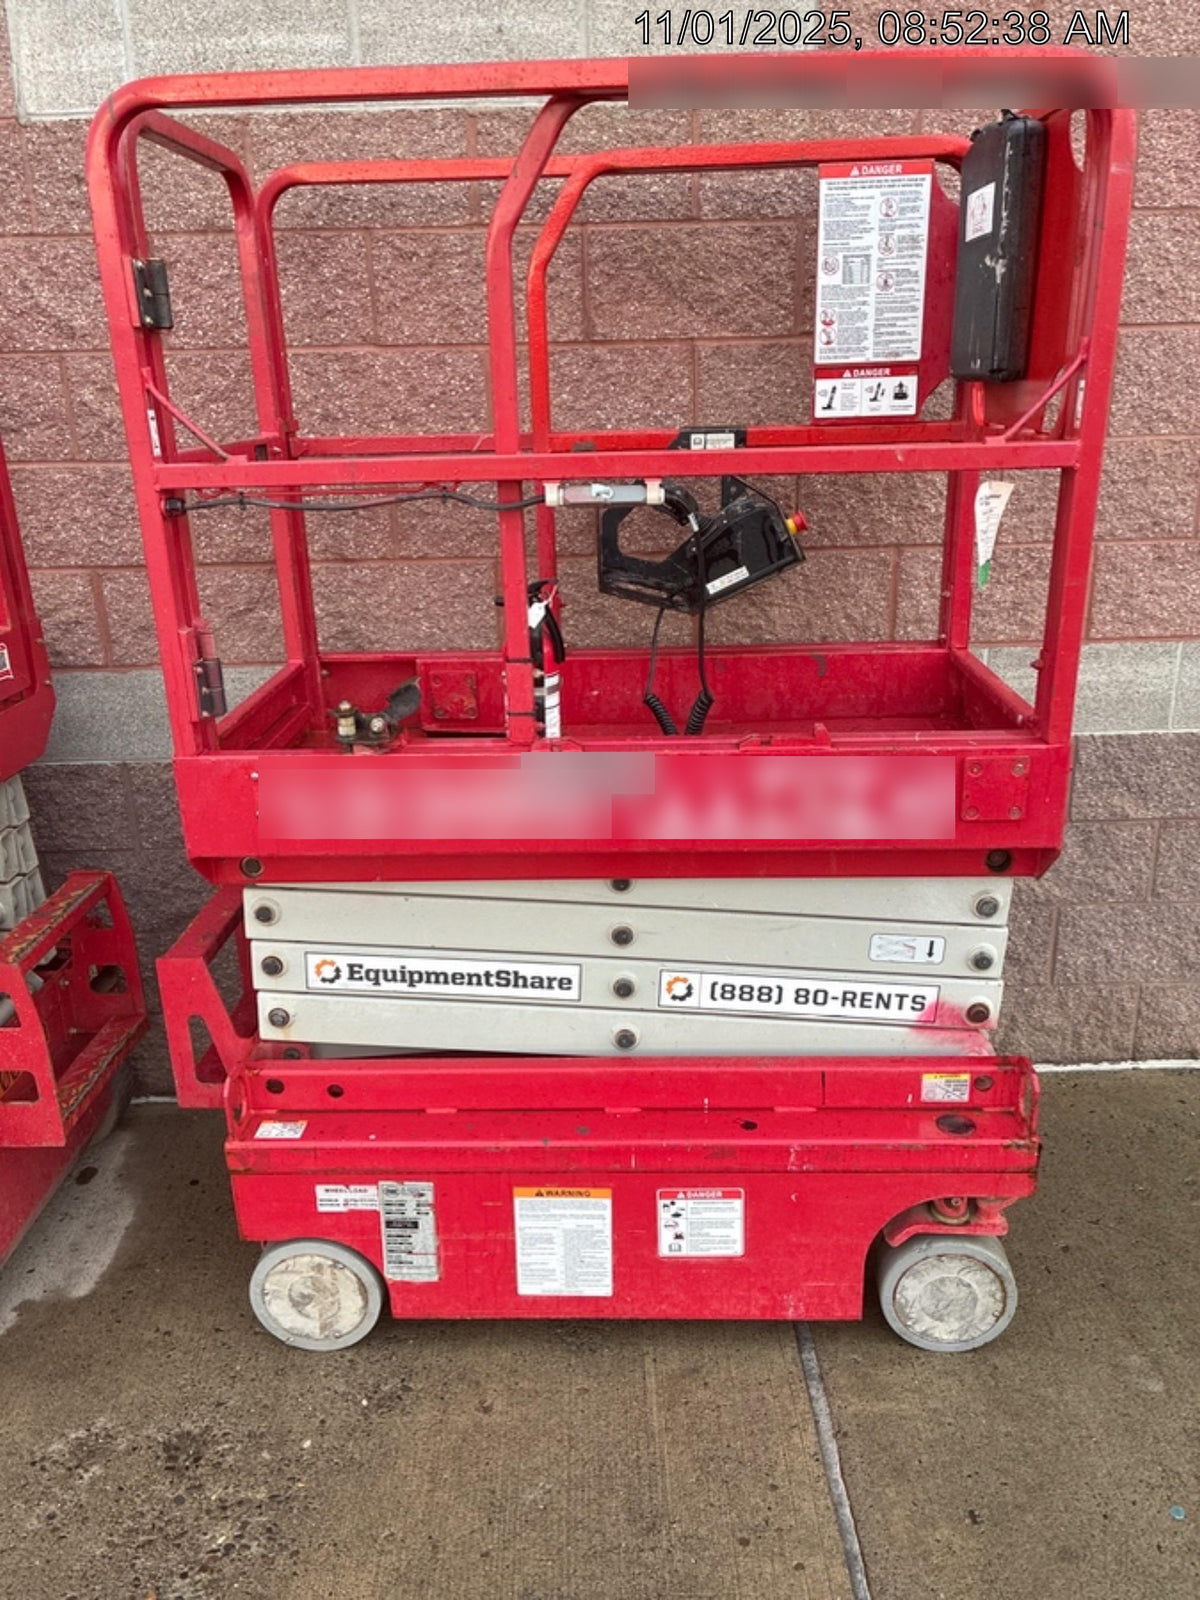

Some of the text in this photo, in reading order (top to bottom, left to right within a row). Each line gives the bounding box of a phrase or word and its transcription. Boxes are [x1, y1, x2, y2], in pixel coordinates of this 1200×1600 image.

[861, 163, 903, 175] DANGER
[852, 367, 891, 378] DANGER
[346, 962, 573, 991] EquipmentShare
[709, 980, 927, 1013] (888) 80-RENTS
[545, 1189, 591, 1198] WARNING
[686, 1190, 723, 1199] DANGER
